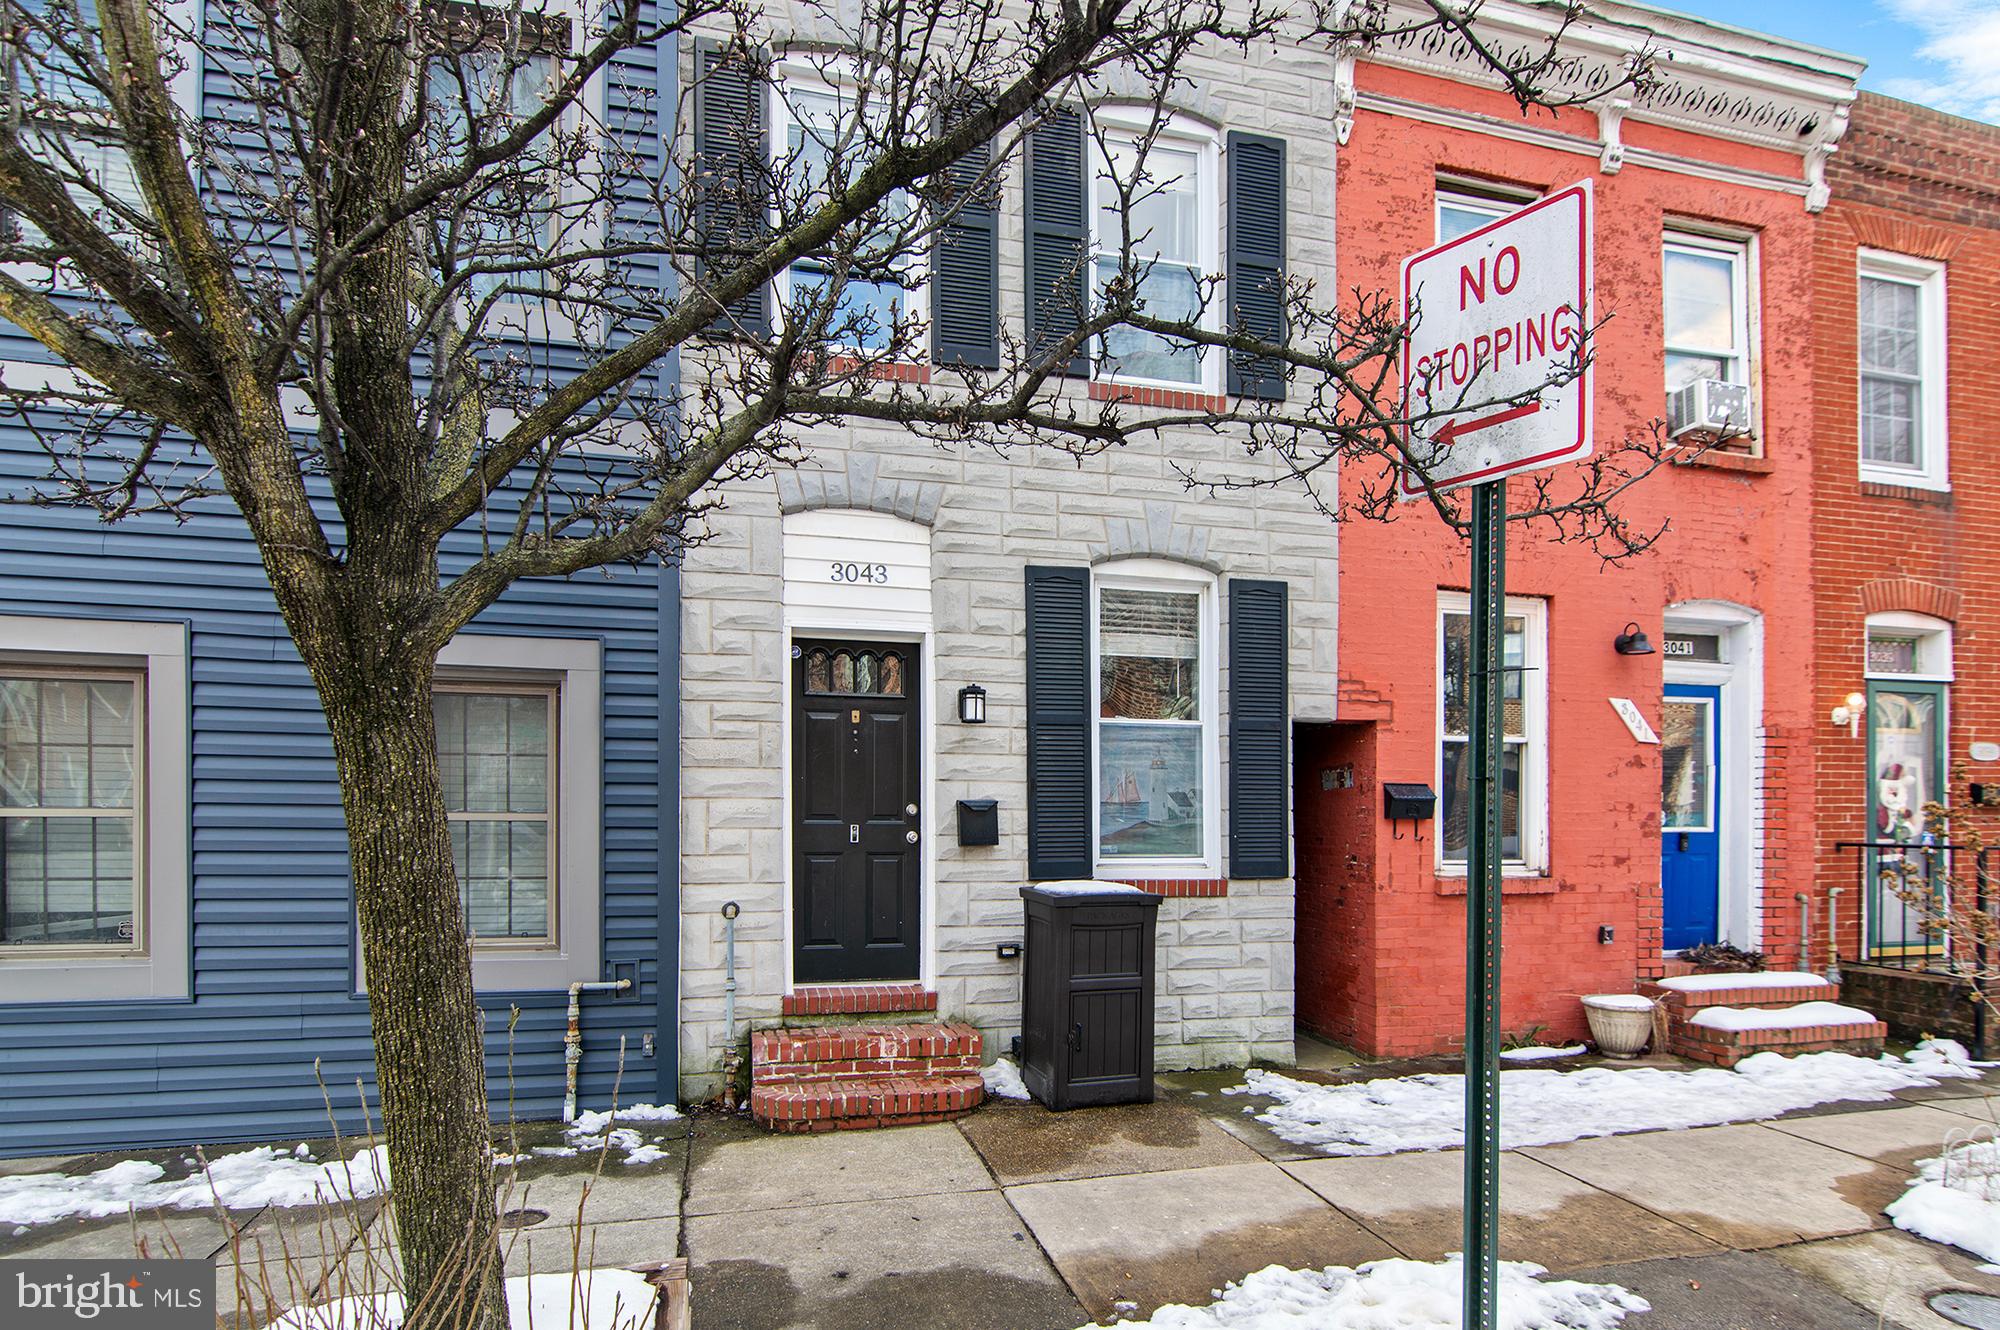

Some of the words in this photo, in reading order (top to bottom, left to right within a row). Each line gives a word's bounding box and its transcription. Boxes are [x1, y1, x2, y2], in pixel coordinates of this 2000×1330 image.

[1460, 246, 1520, 311] NO
[1416, 305, 1571, 397] STOPPING
[831, 562, 888, 584] 3043
[1664, 641, 1691, 654] 3041
[1622, 702, 1648, 740] 3041
